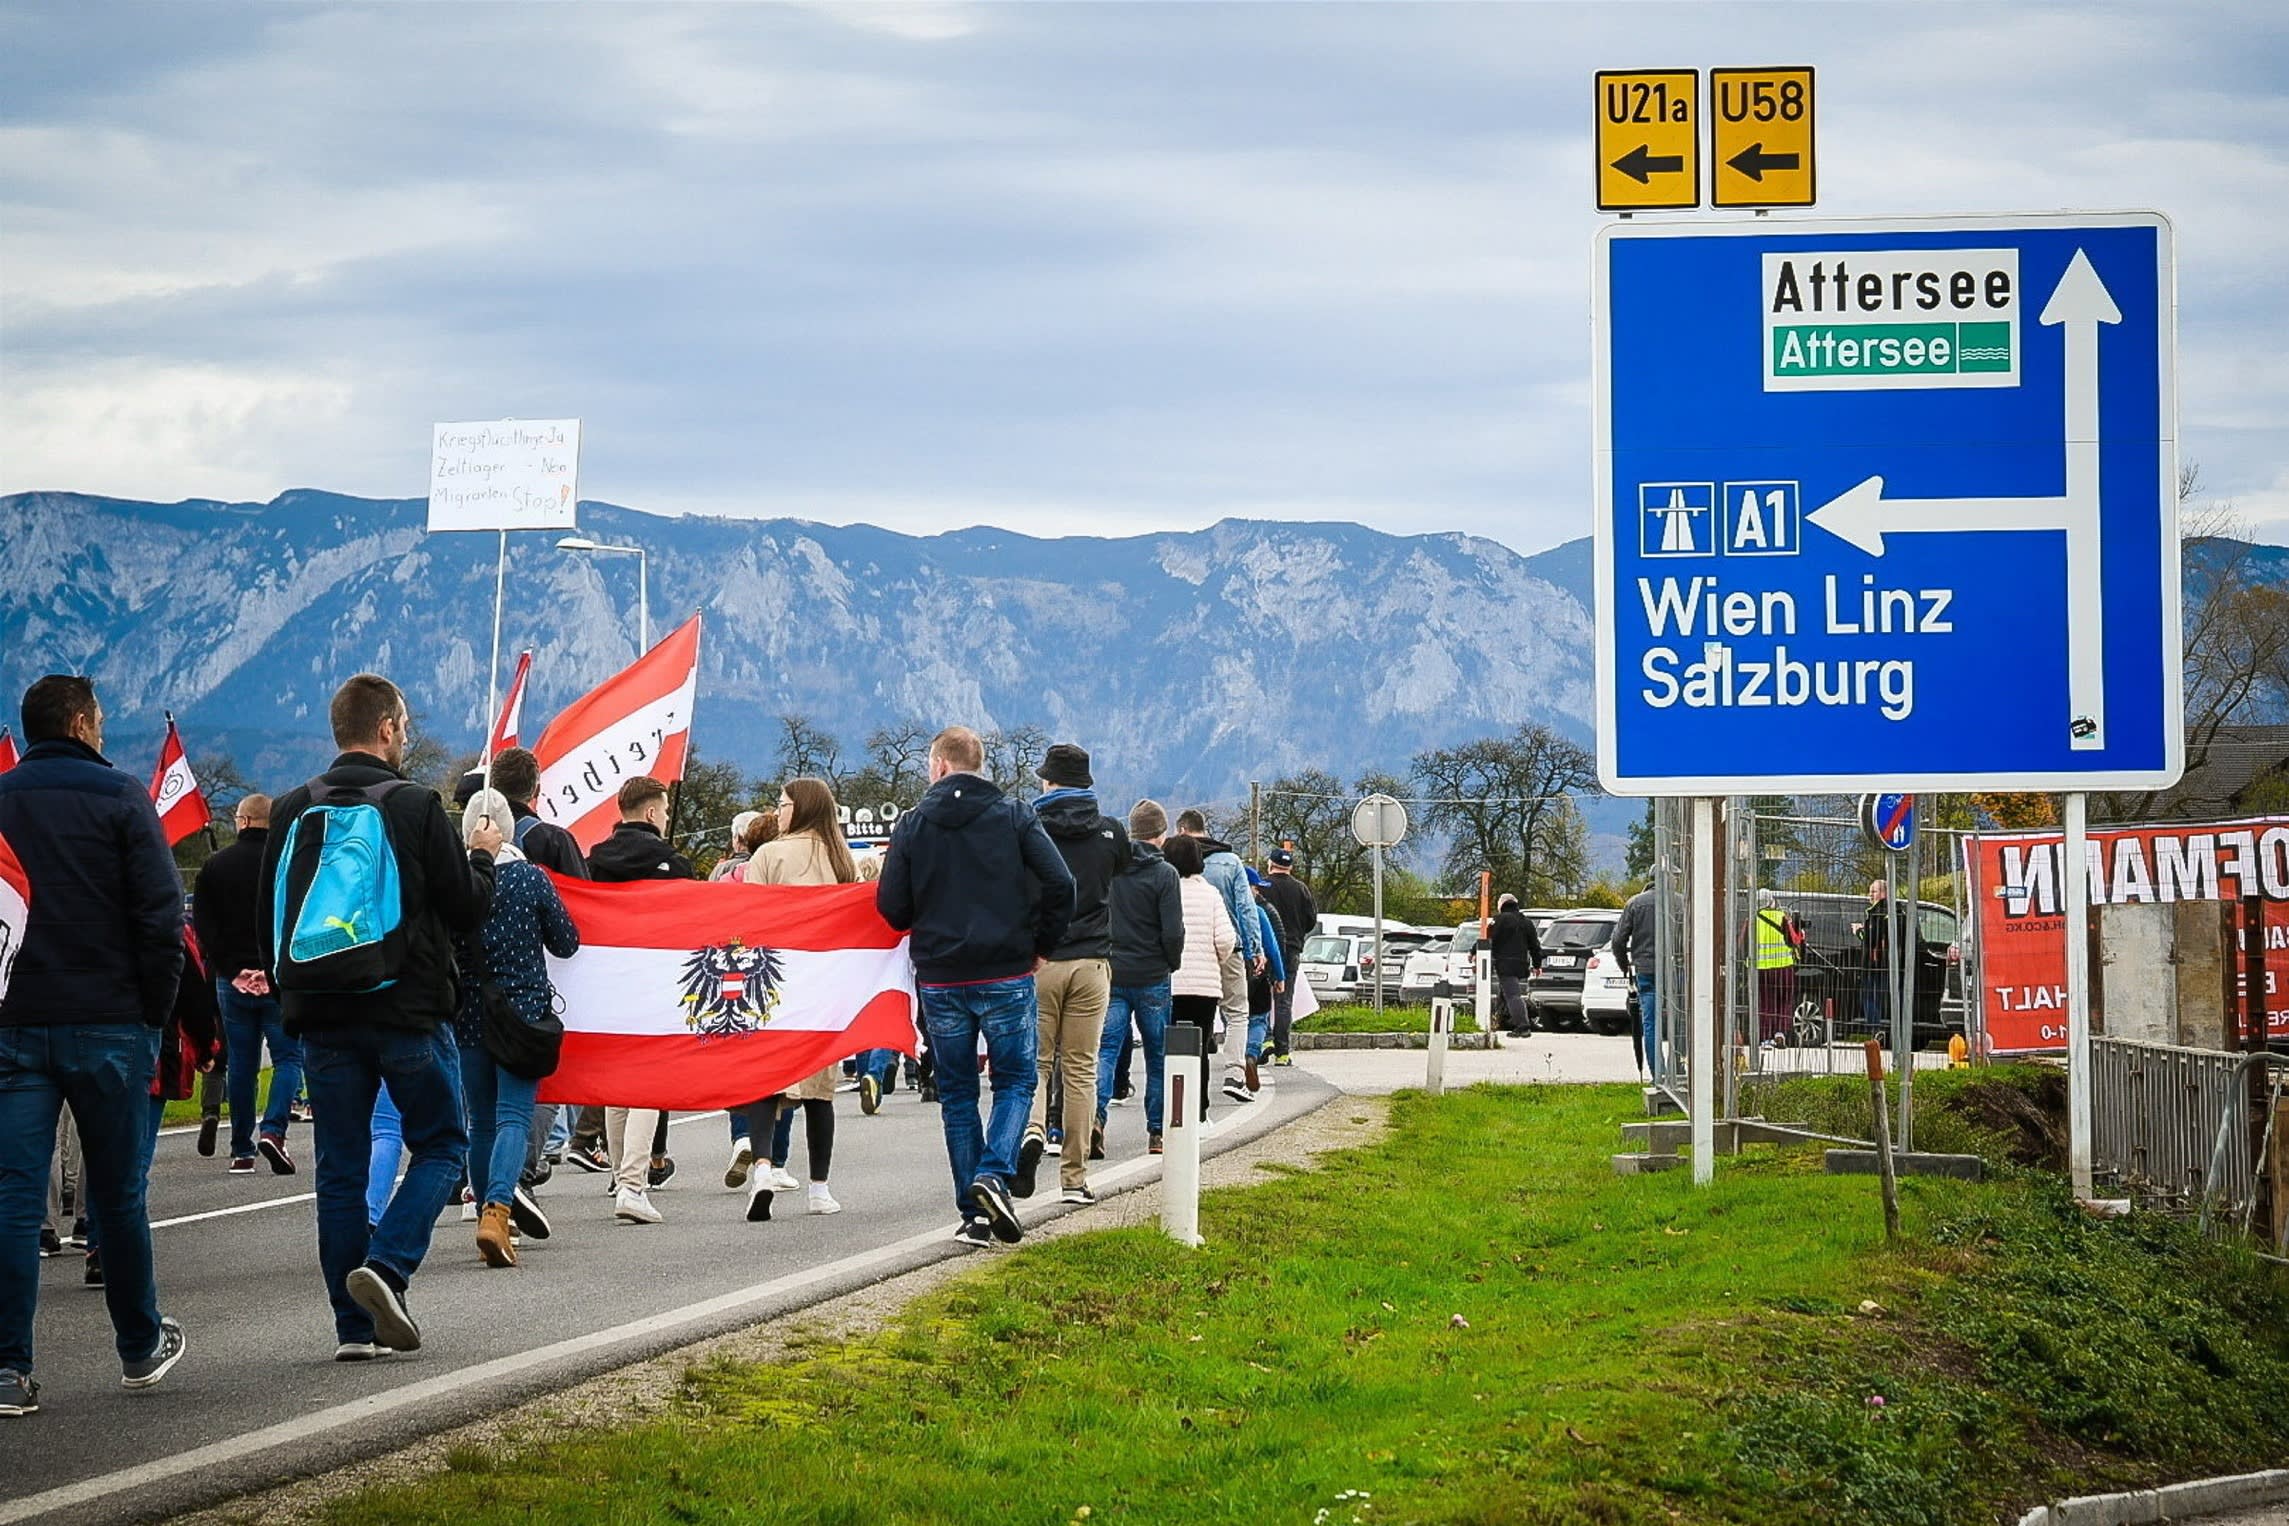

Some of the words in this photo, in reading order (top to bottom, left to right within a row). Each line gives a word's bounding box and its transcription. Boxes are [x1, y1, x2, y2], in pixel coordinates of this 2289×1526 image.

[1607, 82, 1688, 124] U21a
[1720, 80, 1805, 122] U58
[1772, 261, 2011, 313] Attersee
[1779, 330, 1951, 368] Attersee
[1734, 489, 1786, 548] A1
[1637, 576, 1796, 637] Wien
[1825, 573, 1953, 634] Linz
[1642, 646, 1914, 720] Salzburg
[847, 822, 883, 836] Bitte
